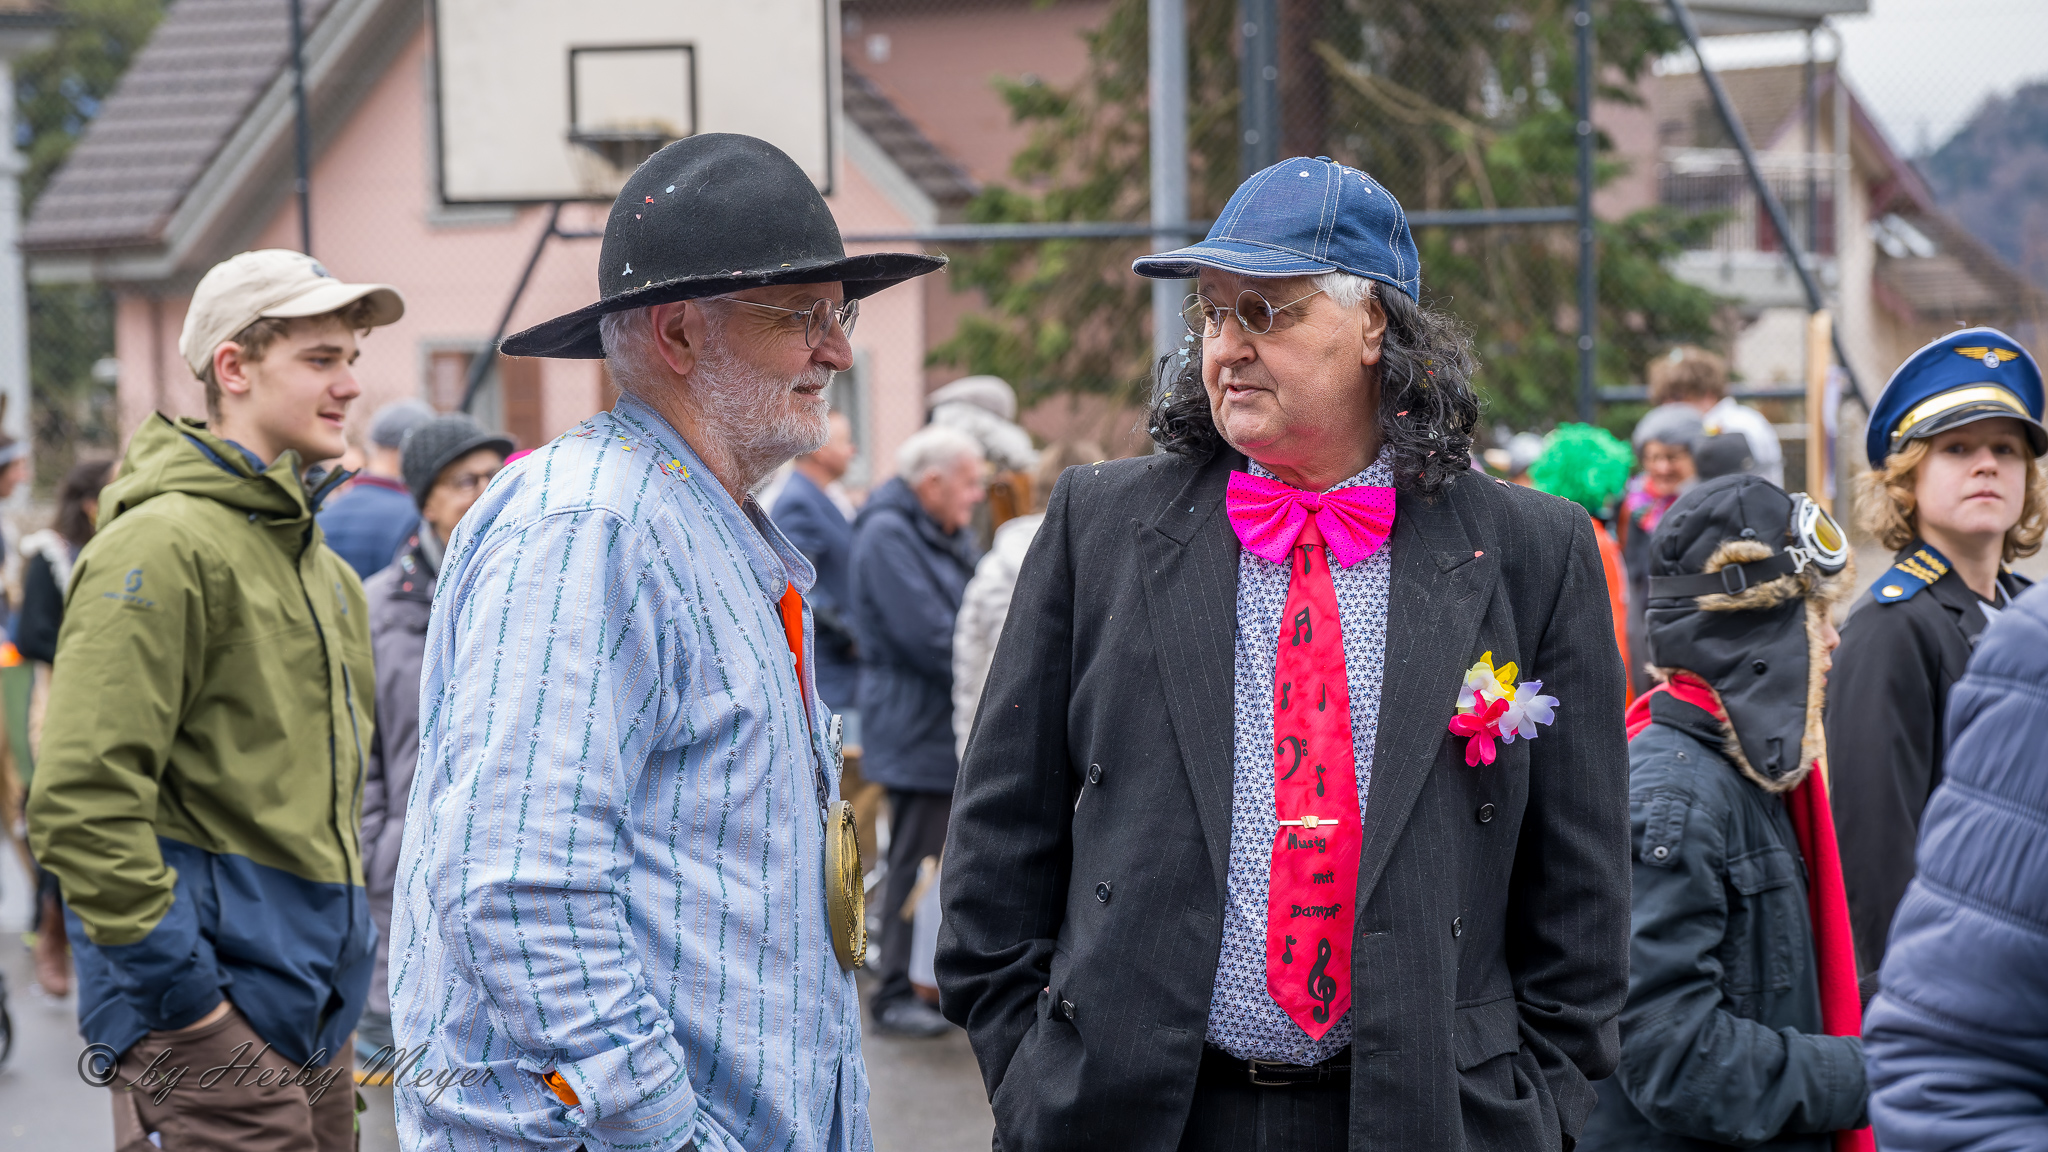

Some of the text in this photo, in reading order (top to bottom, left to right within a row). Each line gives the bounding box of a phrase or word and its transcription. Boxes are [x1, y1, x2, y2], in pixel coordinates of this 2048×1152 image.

[1287, 832, 1326, 853] Musig
[1312, 870, 1335, 884] mit
[1290, 904, 1342, 920] Dampf
